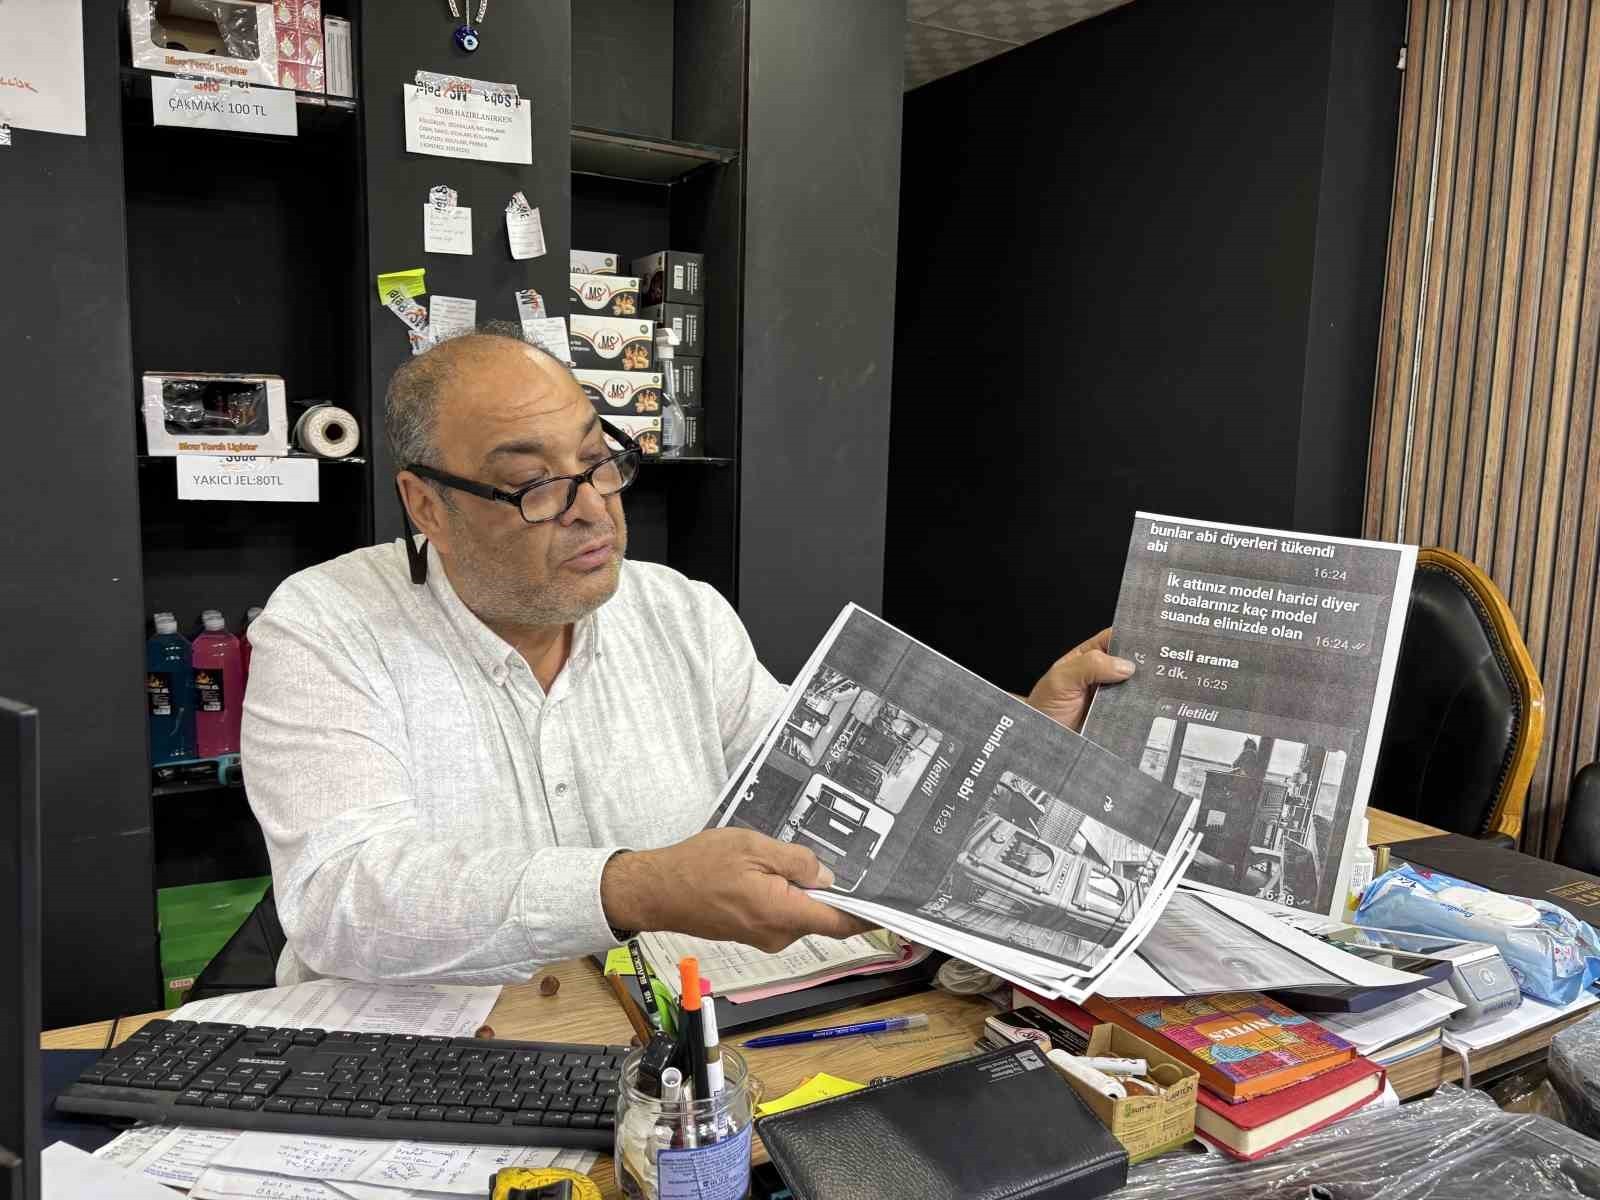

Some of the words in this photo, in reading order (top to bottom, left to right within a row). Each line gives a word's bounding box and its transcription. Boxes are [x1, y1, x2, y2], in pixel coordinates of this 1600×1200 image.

[168, 97, 224, 113] ÇAKMAK:
[227, 102, 250, 115] 100
[253, 104, 268, 117] TL
[178, 442, 202, 452] Blow
[203, 442, 226, 452] Torch
[226, 442, 258, 452] Lighter
[192, 474, 232, 486] YAKICI
[233, 475, 284, 487] JEL:80TL
[1147, 539, 1168, 554] abi
[1150, 522, 1194, 542] bunlar
[1196, 529, 1218, 544] abi
[1220, 532, 1278, 553] diyerleri
[1280, 539, 1335, 560] tükendi
[1313, 567, 1348, 582] 16:24
[1166, 571, 1181, 588] İk
[1182, 576, 1227, 595] attınız
[1229, 583, 1273, 601] model
[1276, 588, 1319, 607] harici
[1321, 594, 1361, 614] diyer
[1163, 591, 1241, 615] sobalarınız
[1242, 602, 1269, 620] kaç
[1270, 606, 1318, 625] model
[1160, 608, 1211, 627] suanda
[1212, 614, 1269, 636] elinizde
[1271, 623, 1304, 641] olan
[1314, 635, 1349, 650] 16:24
[1159, 645, 1194, 664] Sesli
[1195, 654, 1240, 669] arama
[1156, 664, 1166, 677] 2
[1167, 666, 1189, 681] dk.
[1196, 676, 1229, 691] 16:25
[1176, 702, 1220, 723] İletildi
[830, 728, 855, 759] 16:29
[981, 714, 1015, 760] Bunlar
[956, 776, 976, 801] abi
[932, 803, 956, 835] 16:29
[1207, 1018, 1275, 1041] NOTES
